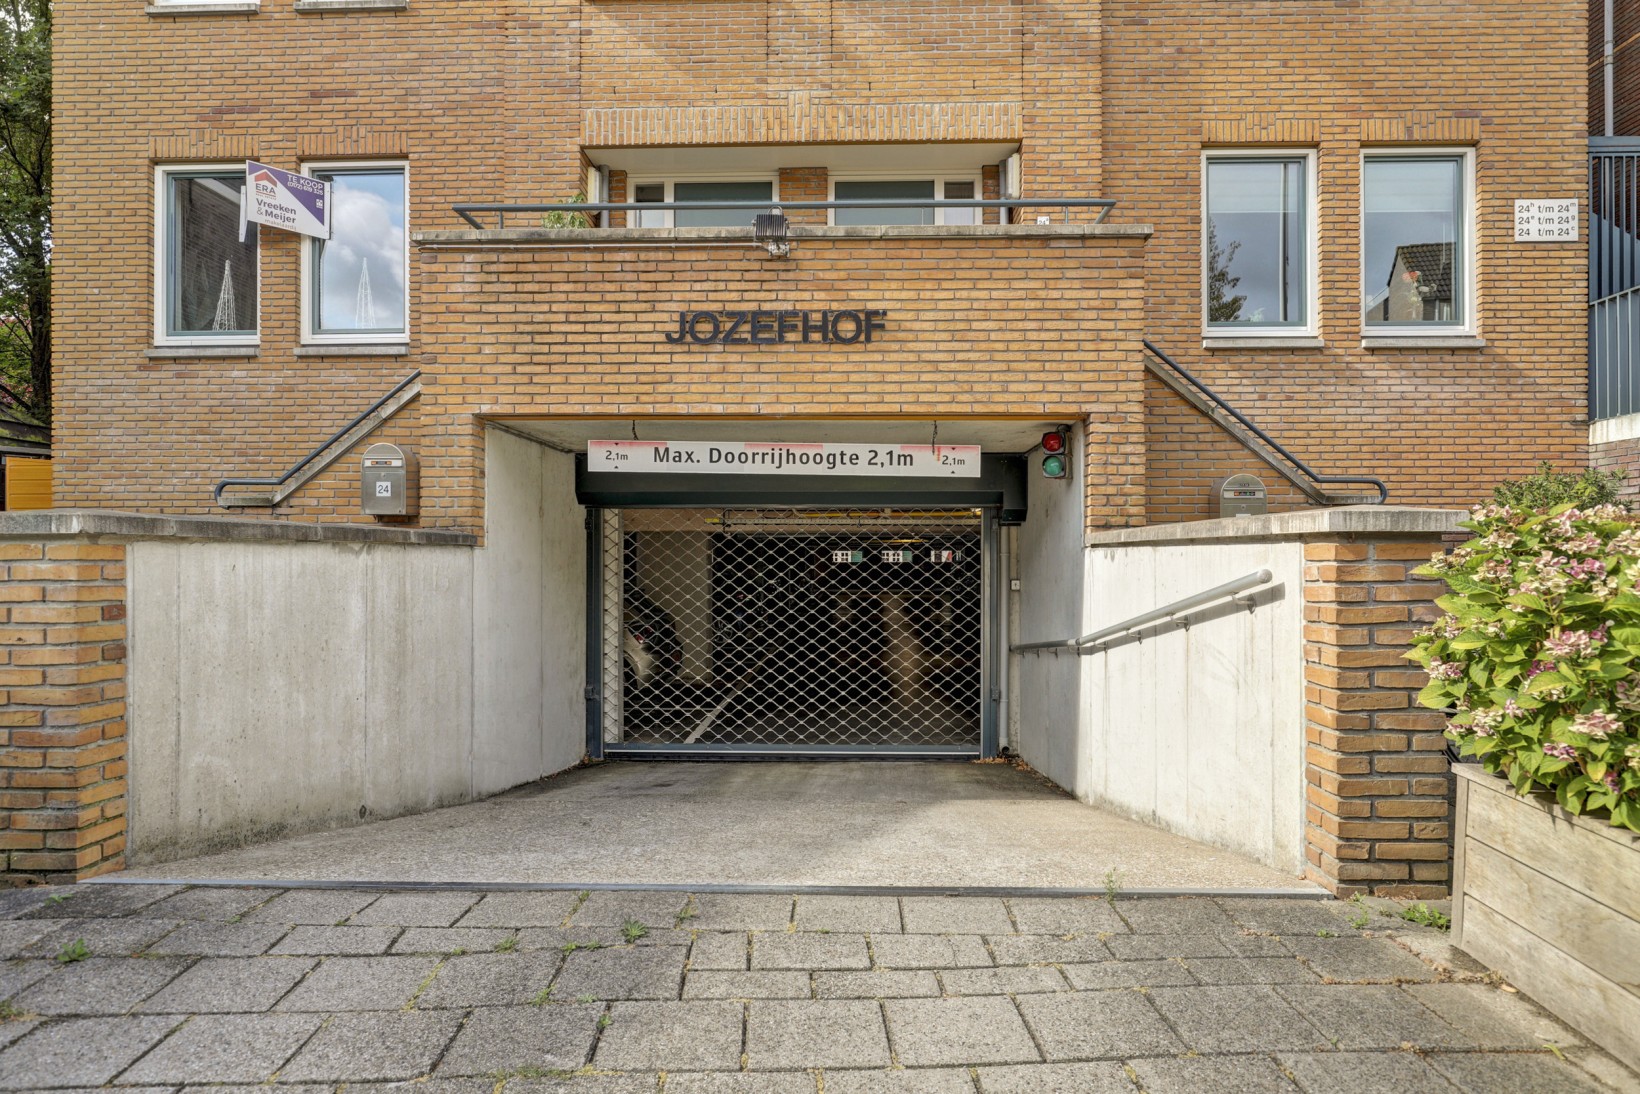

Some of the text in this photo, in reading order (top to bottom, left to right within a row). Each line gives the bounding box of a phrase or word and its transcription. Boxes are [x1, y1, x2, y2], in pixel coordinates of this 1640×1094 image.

[287, 174, 324, 189] TE KOOP
[256, 183, 276, 194] ERA
[256, 198, 296, 215] Vreeken
[1538, 204, 1554, 214] t/m
[256, 207, 296, 223] & Meijer
[1538, 216, 1554, 225] t/m
[1518, 228, 1530, 236] 24
[1538, 228, 1554, 237] t/m
[665, 310, 888, 344] JOZEFHOF
[605, 450, 628, 461] 2,1m
[653, 446, 914, 470] Max. Doorrijhoogte 2,1m
[942, 455, 966, 466] 2,1m
[378, 485, 389, 494] 24
